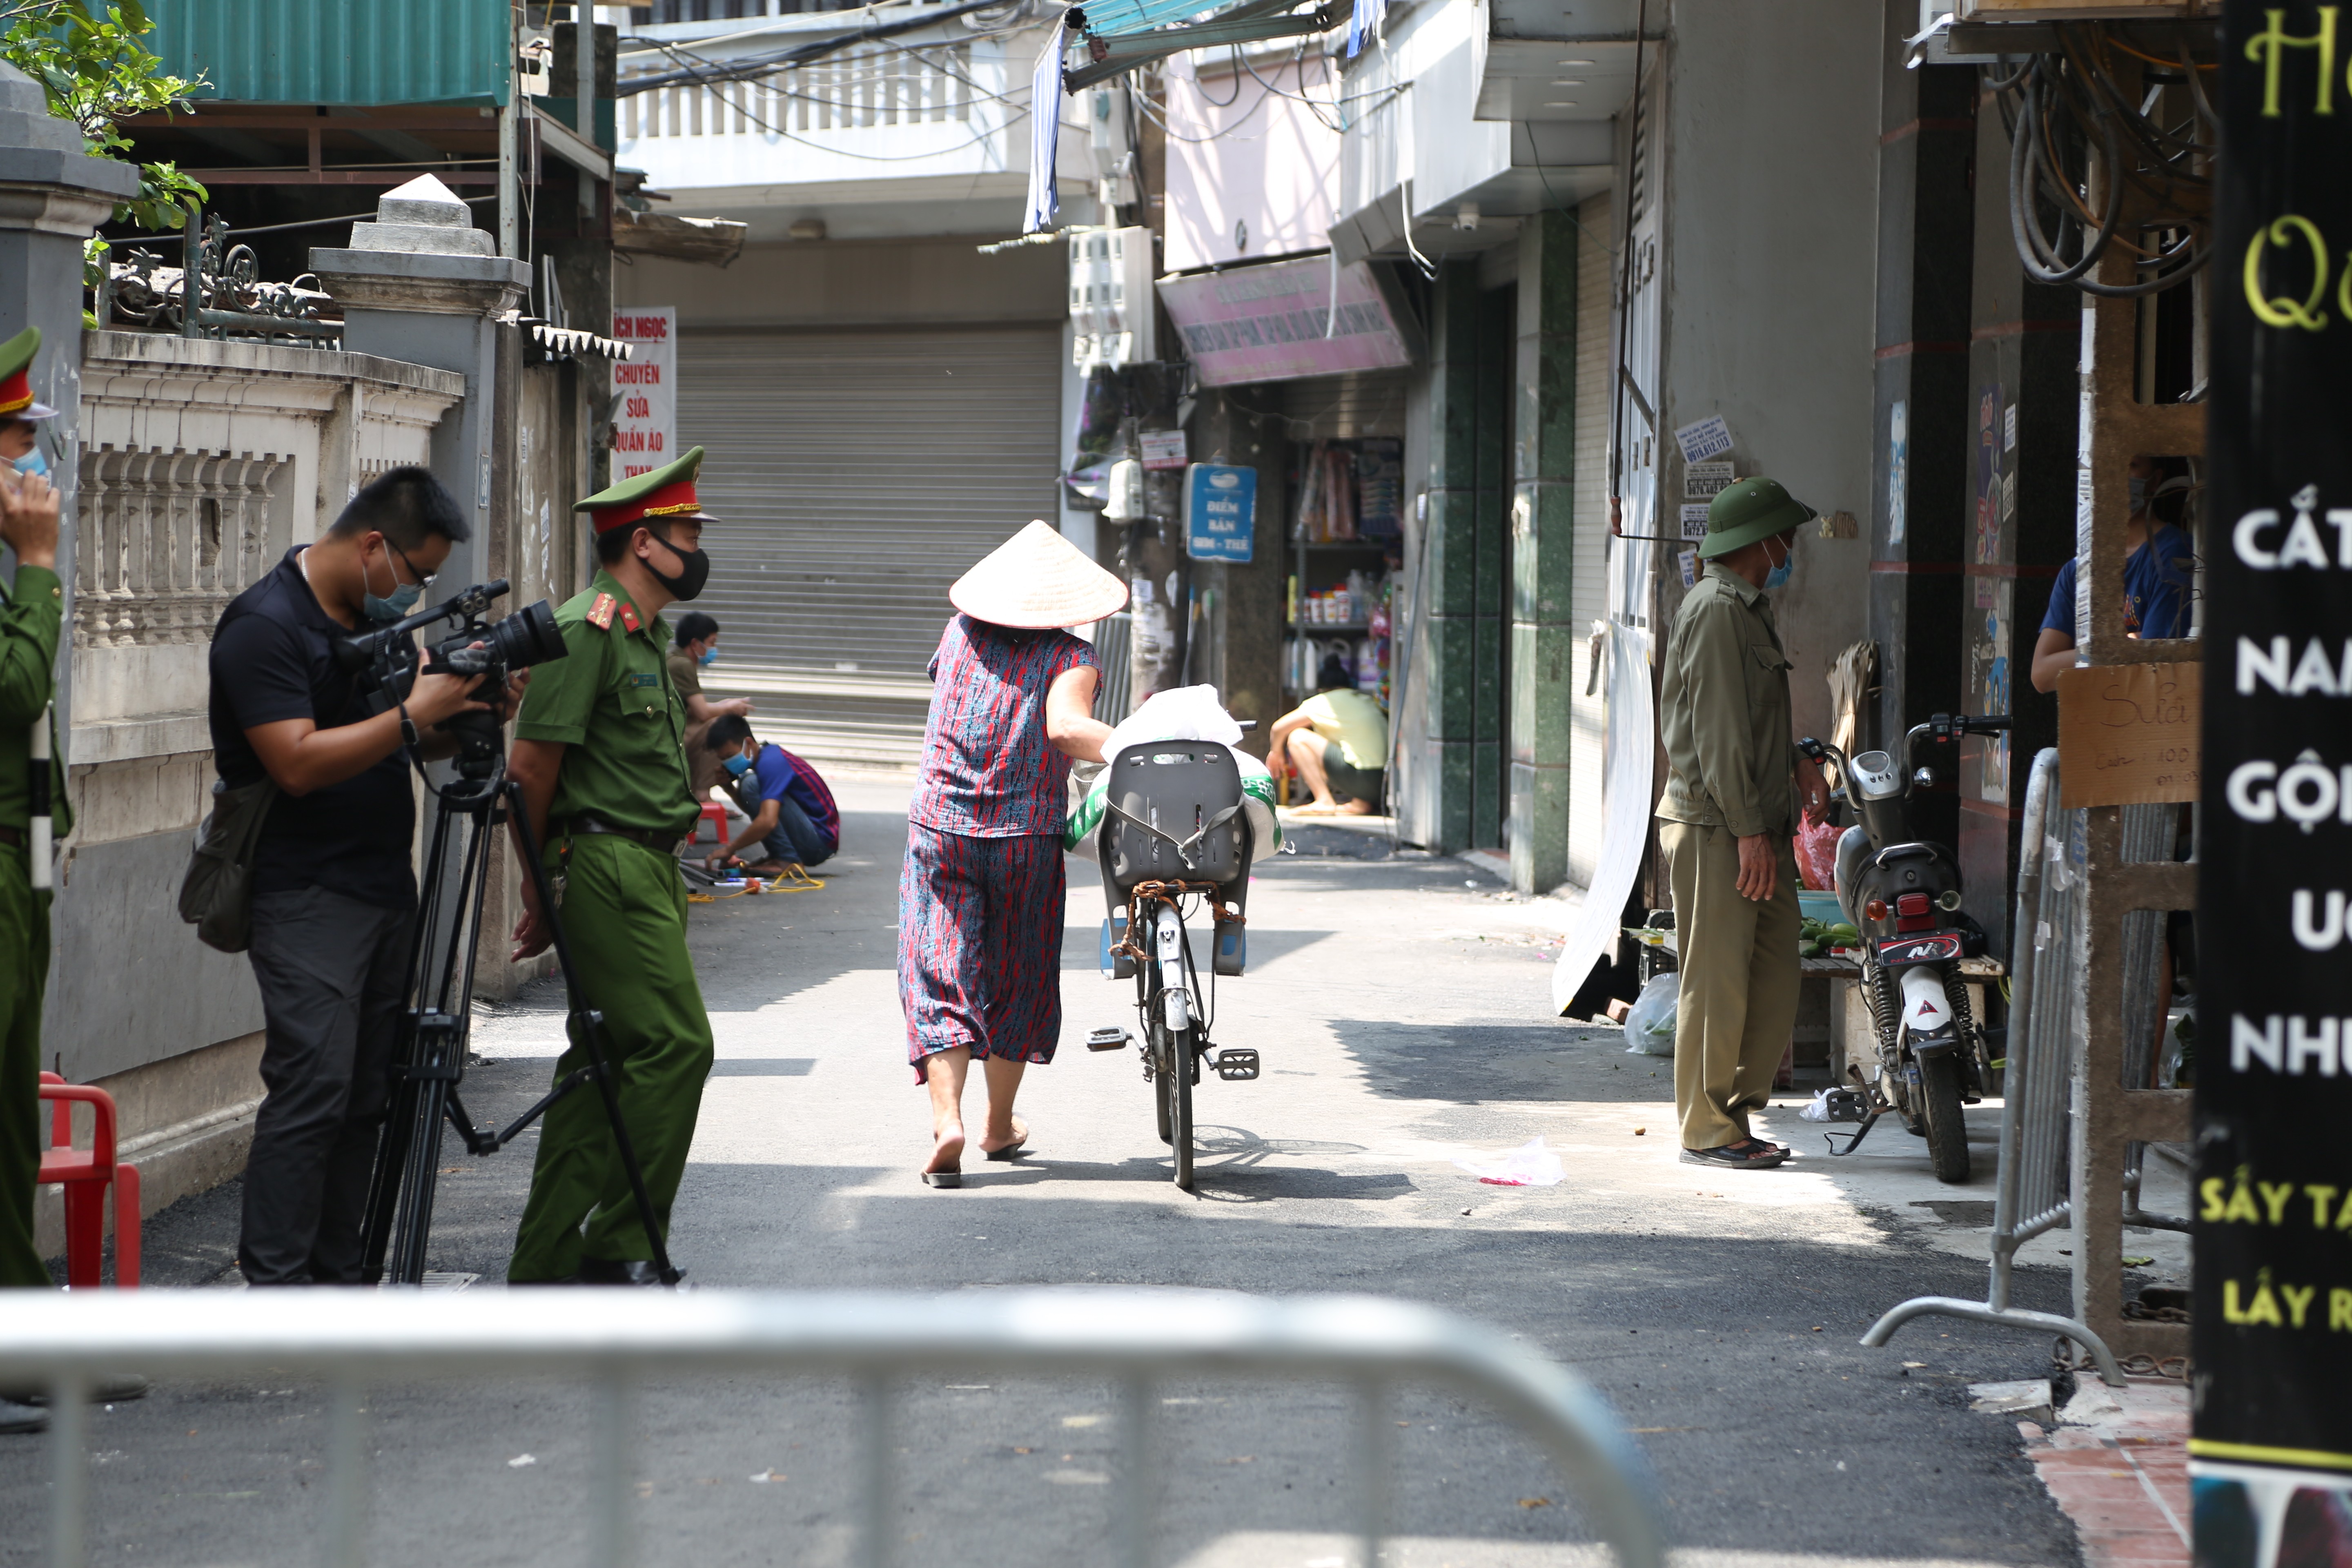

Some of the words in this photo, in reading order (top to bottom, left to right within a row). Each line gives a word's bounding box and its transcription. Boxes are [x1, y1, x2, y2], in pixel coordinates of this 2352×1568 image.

[2244, 6, 2352, 117] H
[2243, 214, 2352, 331] Q
[635, 316, 666, 343] NGỌC
[615, 360, 659, 384] CHUYÊN
[627, 390, 649, 418] SỬA
[648, 427, 662, 451] ÁO
[1686, 435, 1731, 462] 0916.612.113
[1688, 485, 1727, 494] 0976.402.
[2292, 888, 2352, 951] U
[2230, 1012, 2352, 1078] NH
[2199, 1164, 2294, 1226] SẤY
[2223, 1266, 2315, 1330] LẤY
